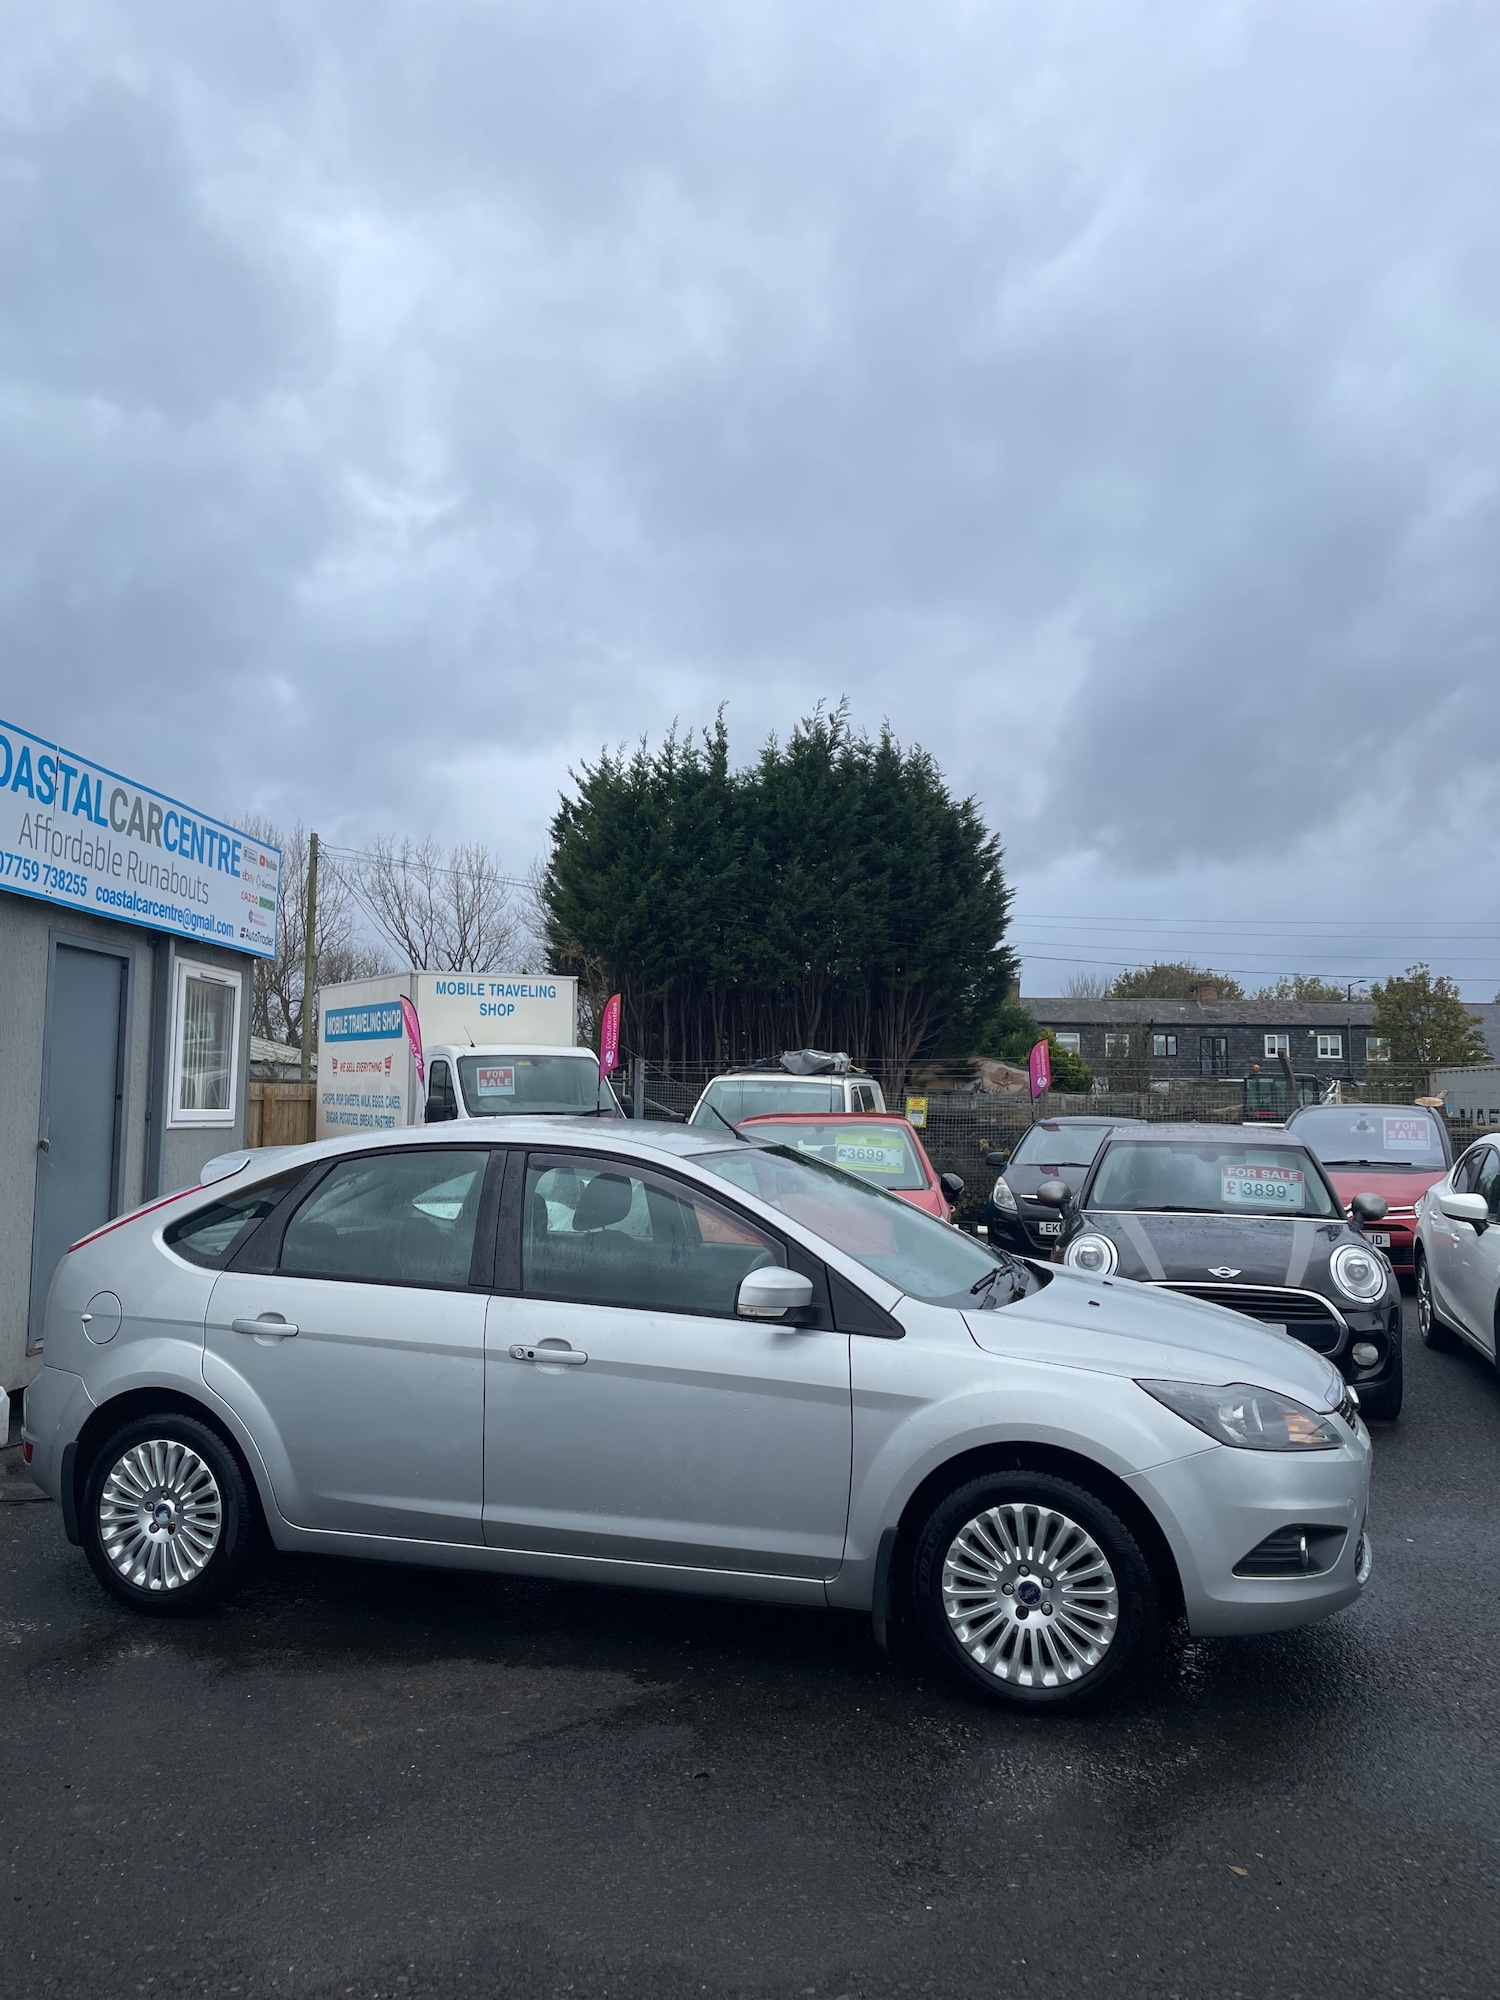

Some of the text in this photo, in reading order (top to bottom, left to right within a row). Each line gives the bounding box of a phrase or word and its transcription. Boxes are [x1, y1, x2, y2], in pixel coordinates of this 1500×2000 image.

[18, 812, 209, 905] Affordable Runabouts
[43, 864, 88, 897] 738255
[95, 886, 234, 938] coastalcarcentre@gmail.com
[436, 981, 557, 998] MOBILE TRAVELING
[479, 1002, 515, 1017] SHOP
[326, 1015, 348, 1035] MOBILE
[349, 1011, 381, 1034] TRAVELING
[382, 1009, 401, 1031] SHOP
[480, 1078, 511, 1087] SALE
[1395, 1121, 1417, 1130] FOR
[1387, 1130, 1426, 1139] SALE
[1227, 1167, 1298, 1181] FOR SALE
[1045, 1223, 1061, 1233] EK
